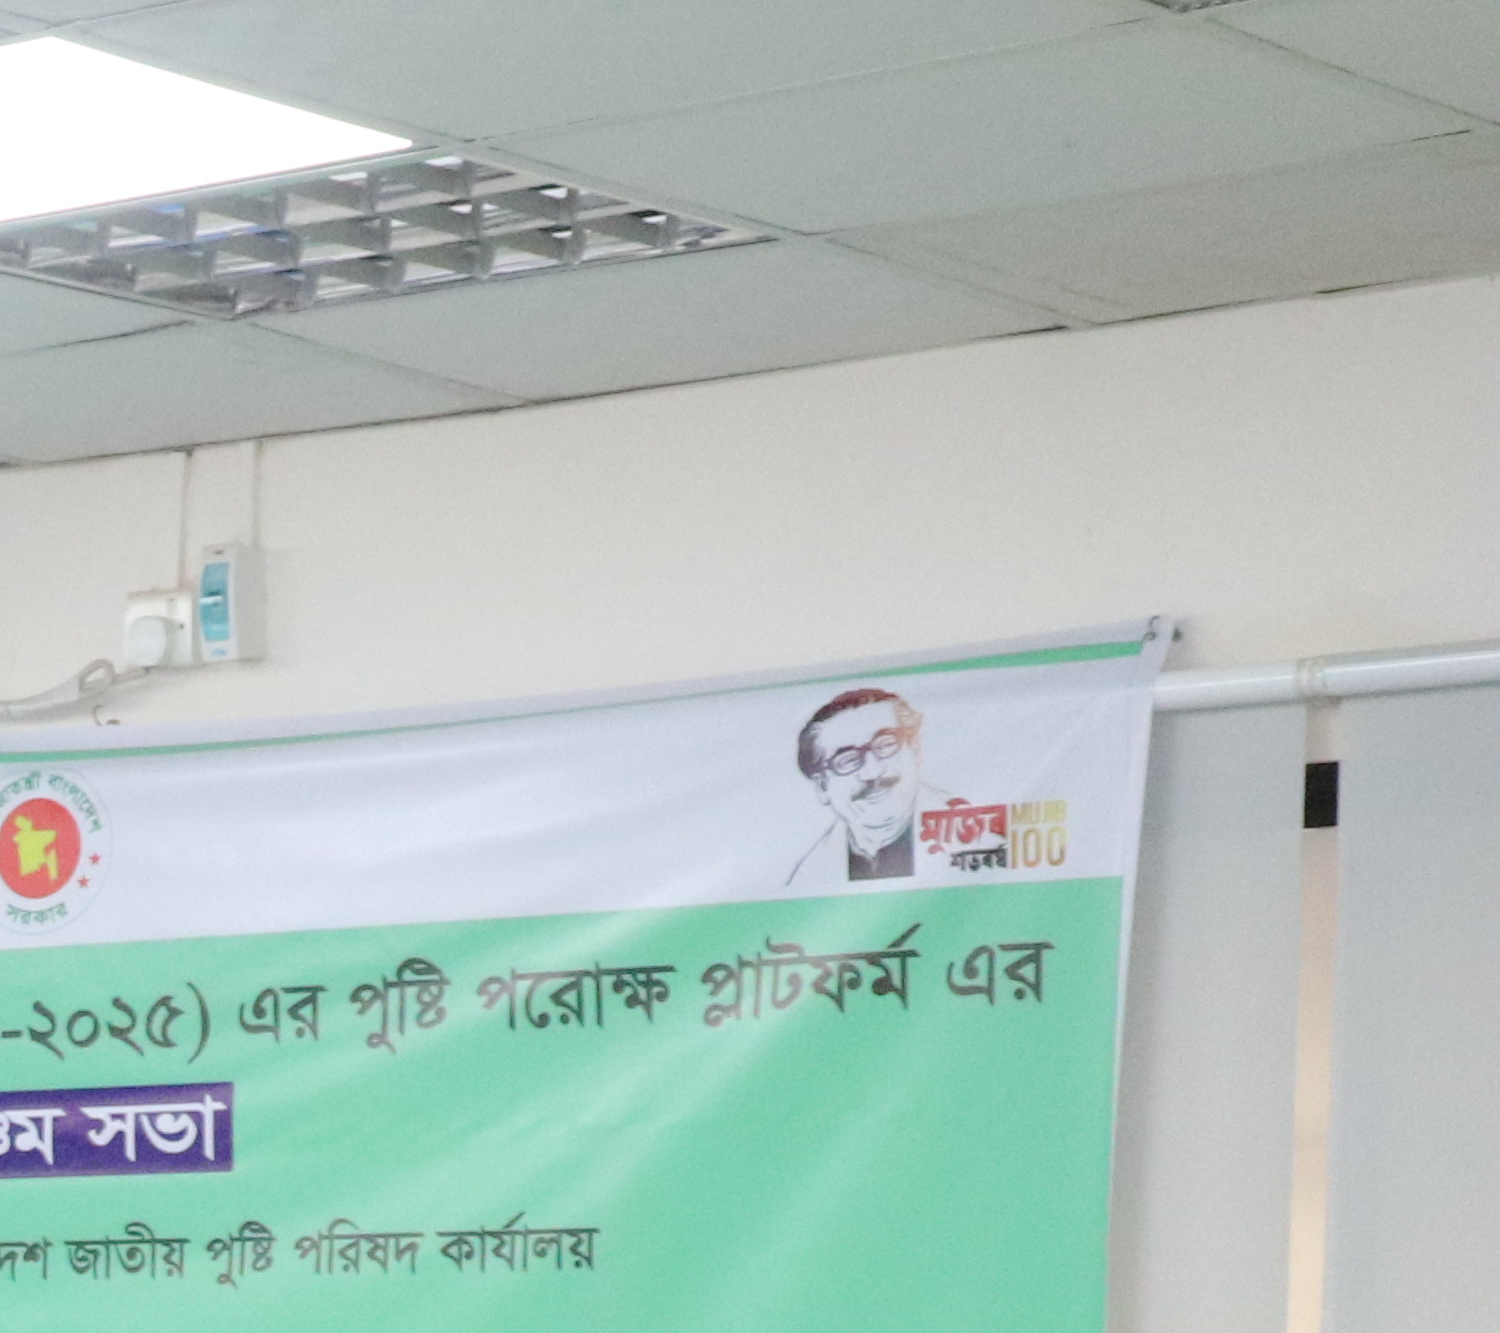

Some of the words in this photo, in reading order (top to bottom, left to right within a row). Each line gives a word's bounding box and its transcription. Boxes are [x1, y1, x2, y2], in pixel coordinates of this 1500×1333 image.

[1011, 826, 1067, 869] 100
[239, 982, 328, 1043] এর
[349, 957, 451, 1053] পুষ্টি
[946, 941, 1056, 1005] এর
[84, 1093, 228, 1161] সভা
[64, 1222, 190, 1279] জাতীয়
[206, 1220, 277, 1288] পুষ্টি
[293, 1217, 425, 1274] পরিষদ
